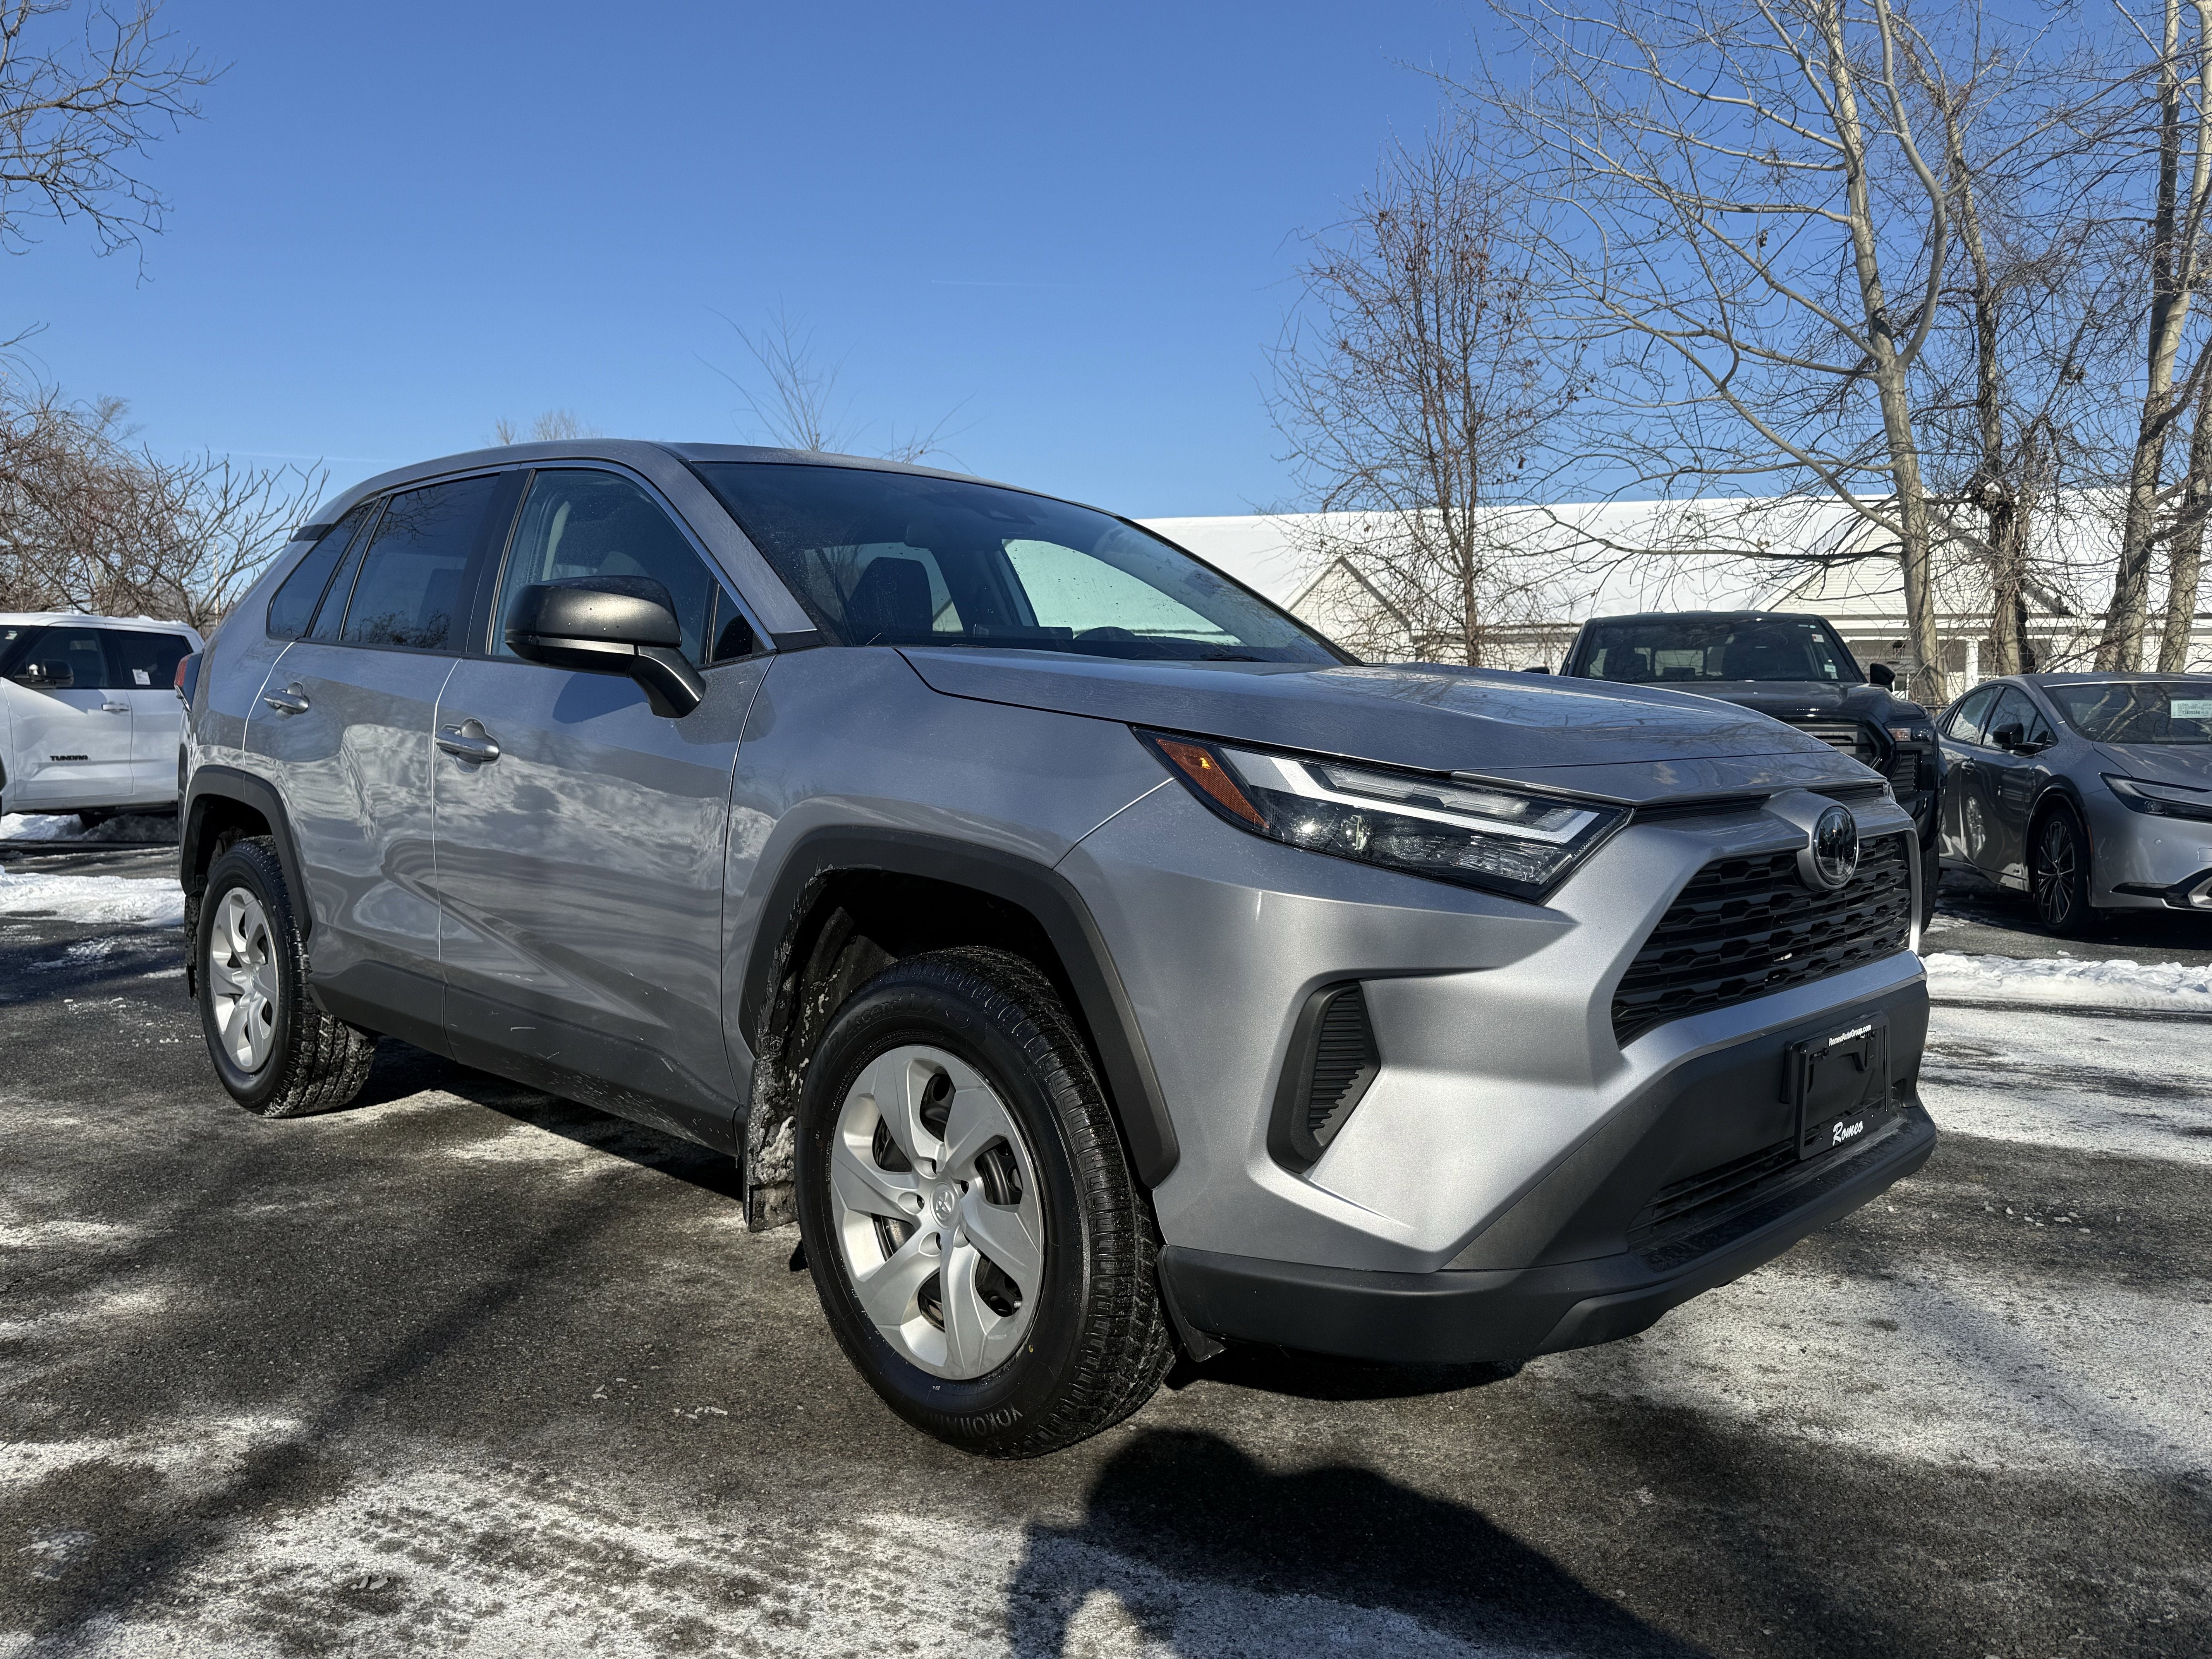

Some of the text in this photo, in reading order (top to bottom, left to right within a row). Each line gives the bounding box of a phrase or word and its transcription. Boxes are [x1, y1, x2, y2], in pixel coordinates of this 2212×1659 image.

[847, 994, 903, 1039] Ascend
[1829, 1024, 1871, 1046] RomeoAutoGroup.com
[1832, 1120, 1863, 1146] Romeo
[920, 1400, 1024, 1437] YOKOHAM
